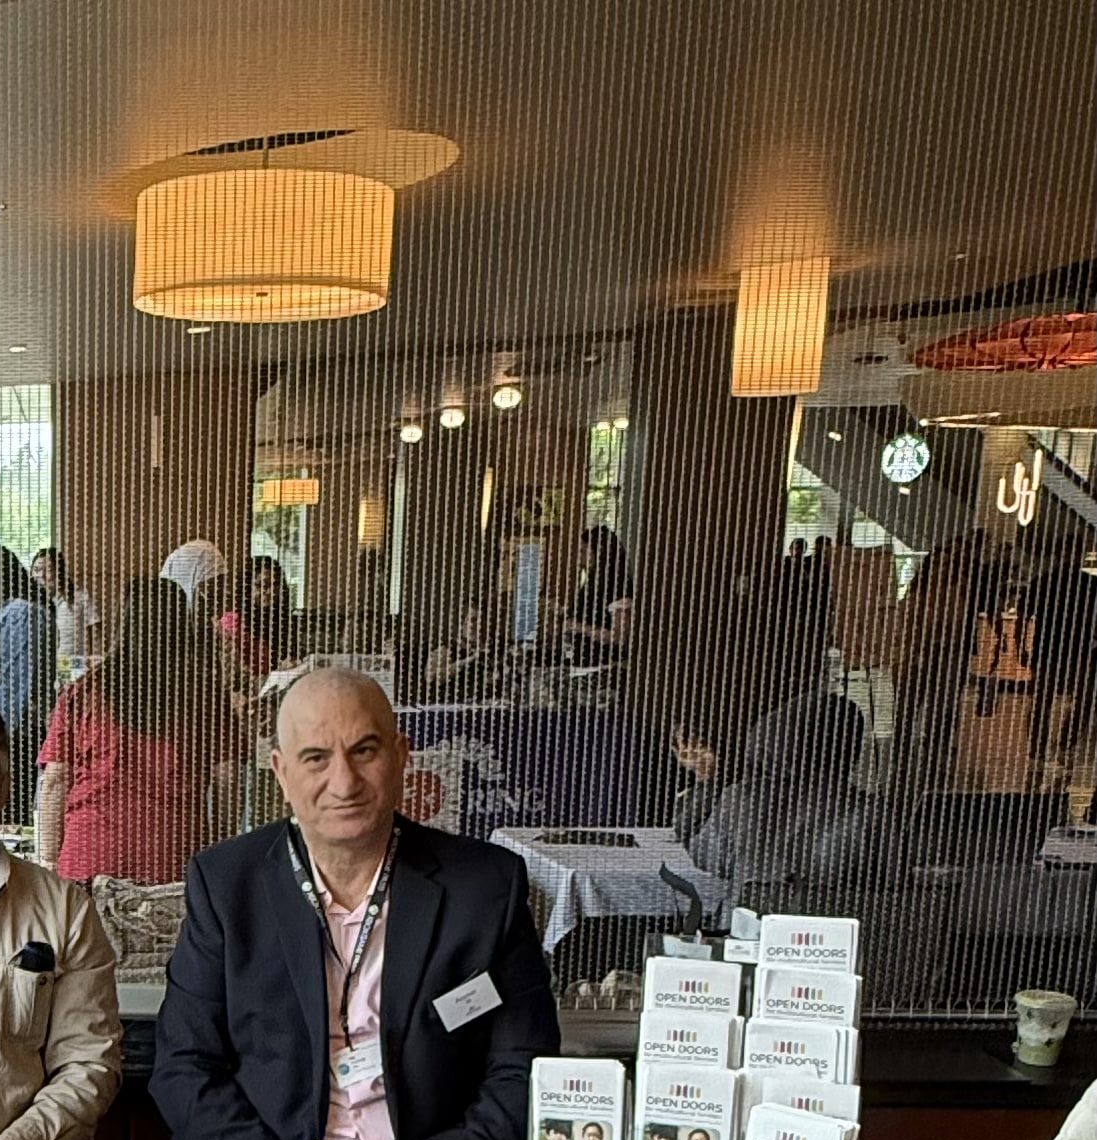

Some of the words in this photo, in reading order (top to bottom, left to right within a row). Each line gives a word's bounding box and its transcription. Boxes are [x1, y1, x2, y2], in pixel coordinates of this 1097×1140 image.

[766, 947, 800, 957] OPEN
[804, 948, 847, 959] DOORS
[656, 993, 688, 1004] OPEN
[690, 995, 730, 1007] DOORS
[766, 999, 800, 1010] OPEN
[803, 1002, 845, 1014] DOORS
[644, 1041, 675, 1053] OPEN
[678, 1044, 719, 1057] DOORS
[749, 1053, 783, 1065] OPEN
[540, 1092, 573, 1103] OPEN
[575, 1094, 614, 1106] DOORS
[646, 1096, 678, 1108] OPEN
[681, 1098, 723, 1113] DOORS
